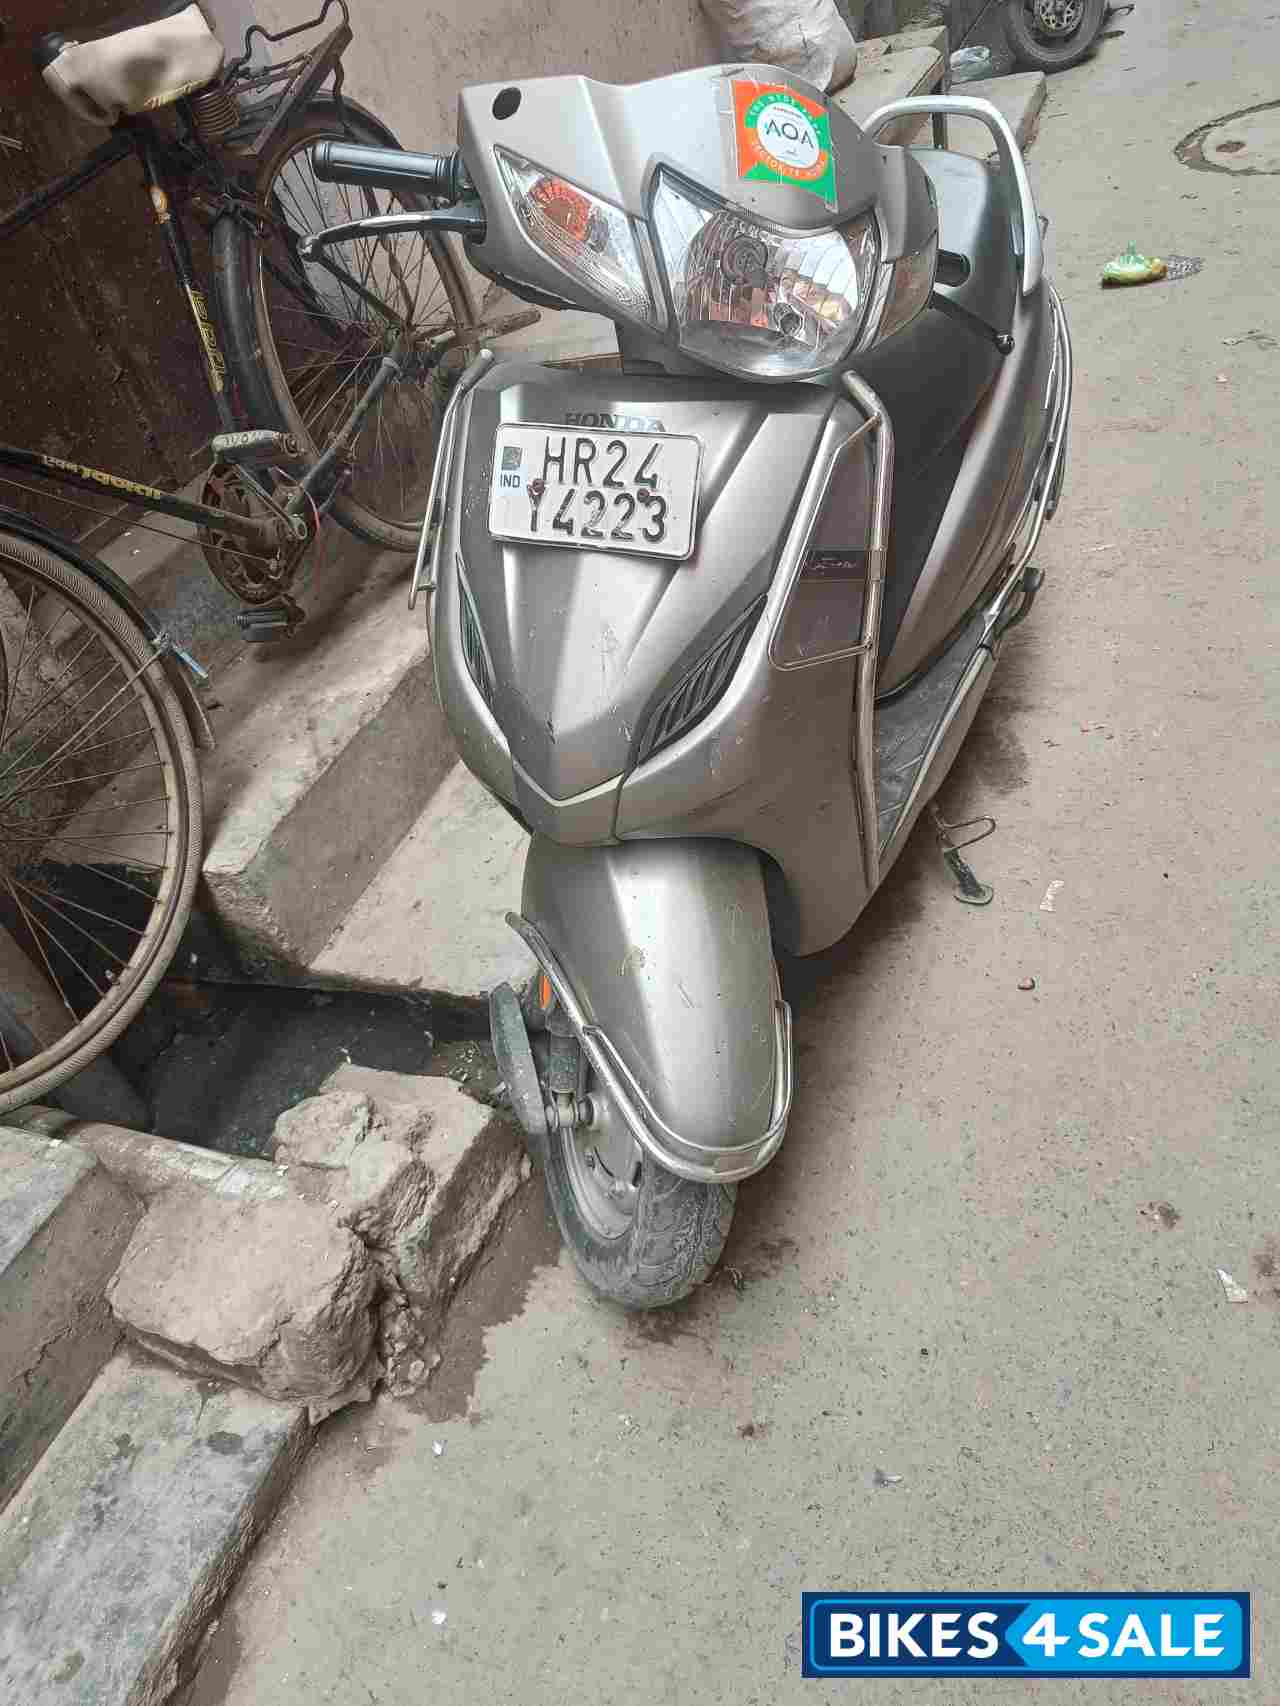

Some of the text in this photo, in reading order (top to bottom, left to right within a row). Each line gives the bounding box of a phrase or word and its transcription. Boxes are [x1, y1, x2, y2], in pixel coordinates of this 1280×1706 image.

[500, 474, 521, 489] IND
[543, 436, 662, 489] HR24
[527, 482, 668, 544] Y4223
